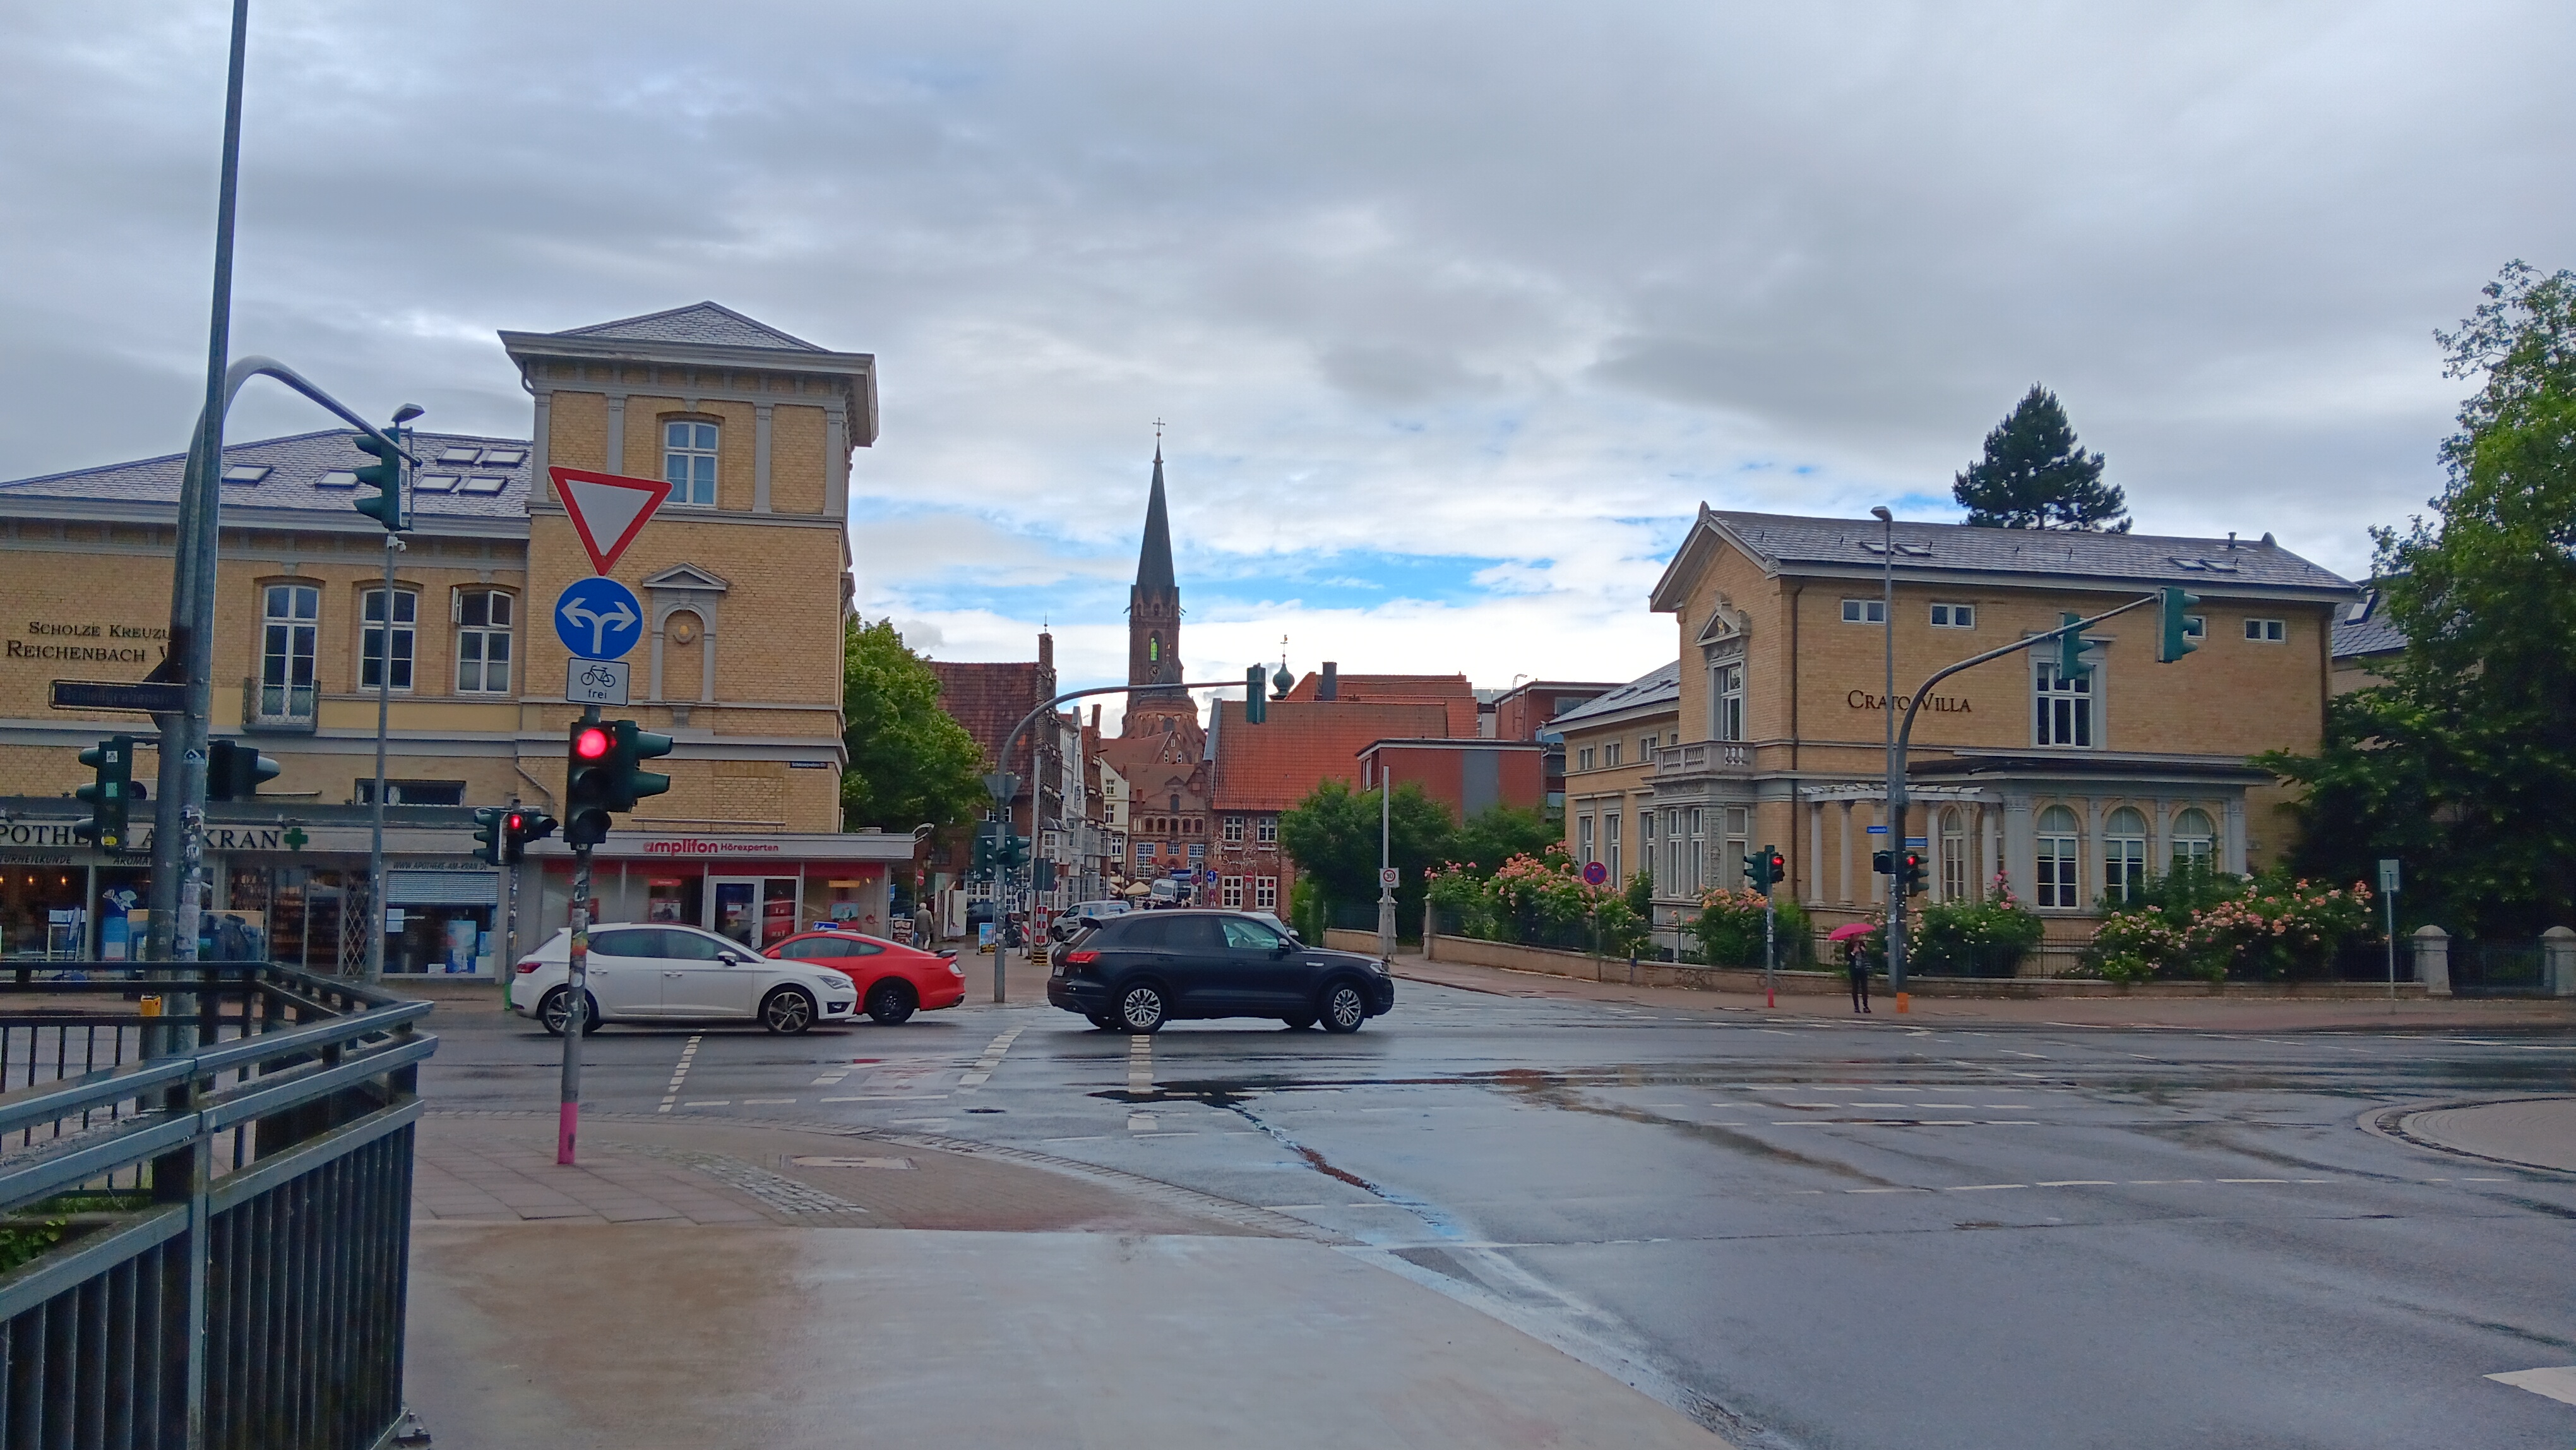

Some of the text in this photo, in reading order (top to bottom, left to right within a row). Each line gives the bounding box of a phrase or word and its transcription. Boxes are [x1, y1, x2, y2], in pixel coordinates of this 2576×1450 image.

[6, 639, 145, 662] REICHENBACH
[588, 689, 607, 699] frei
[643, 838, 778, 856] amplifon Hörexperten
